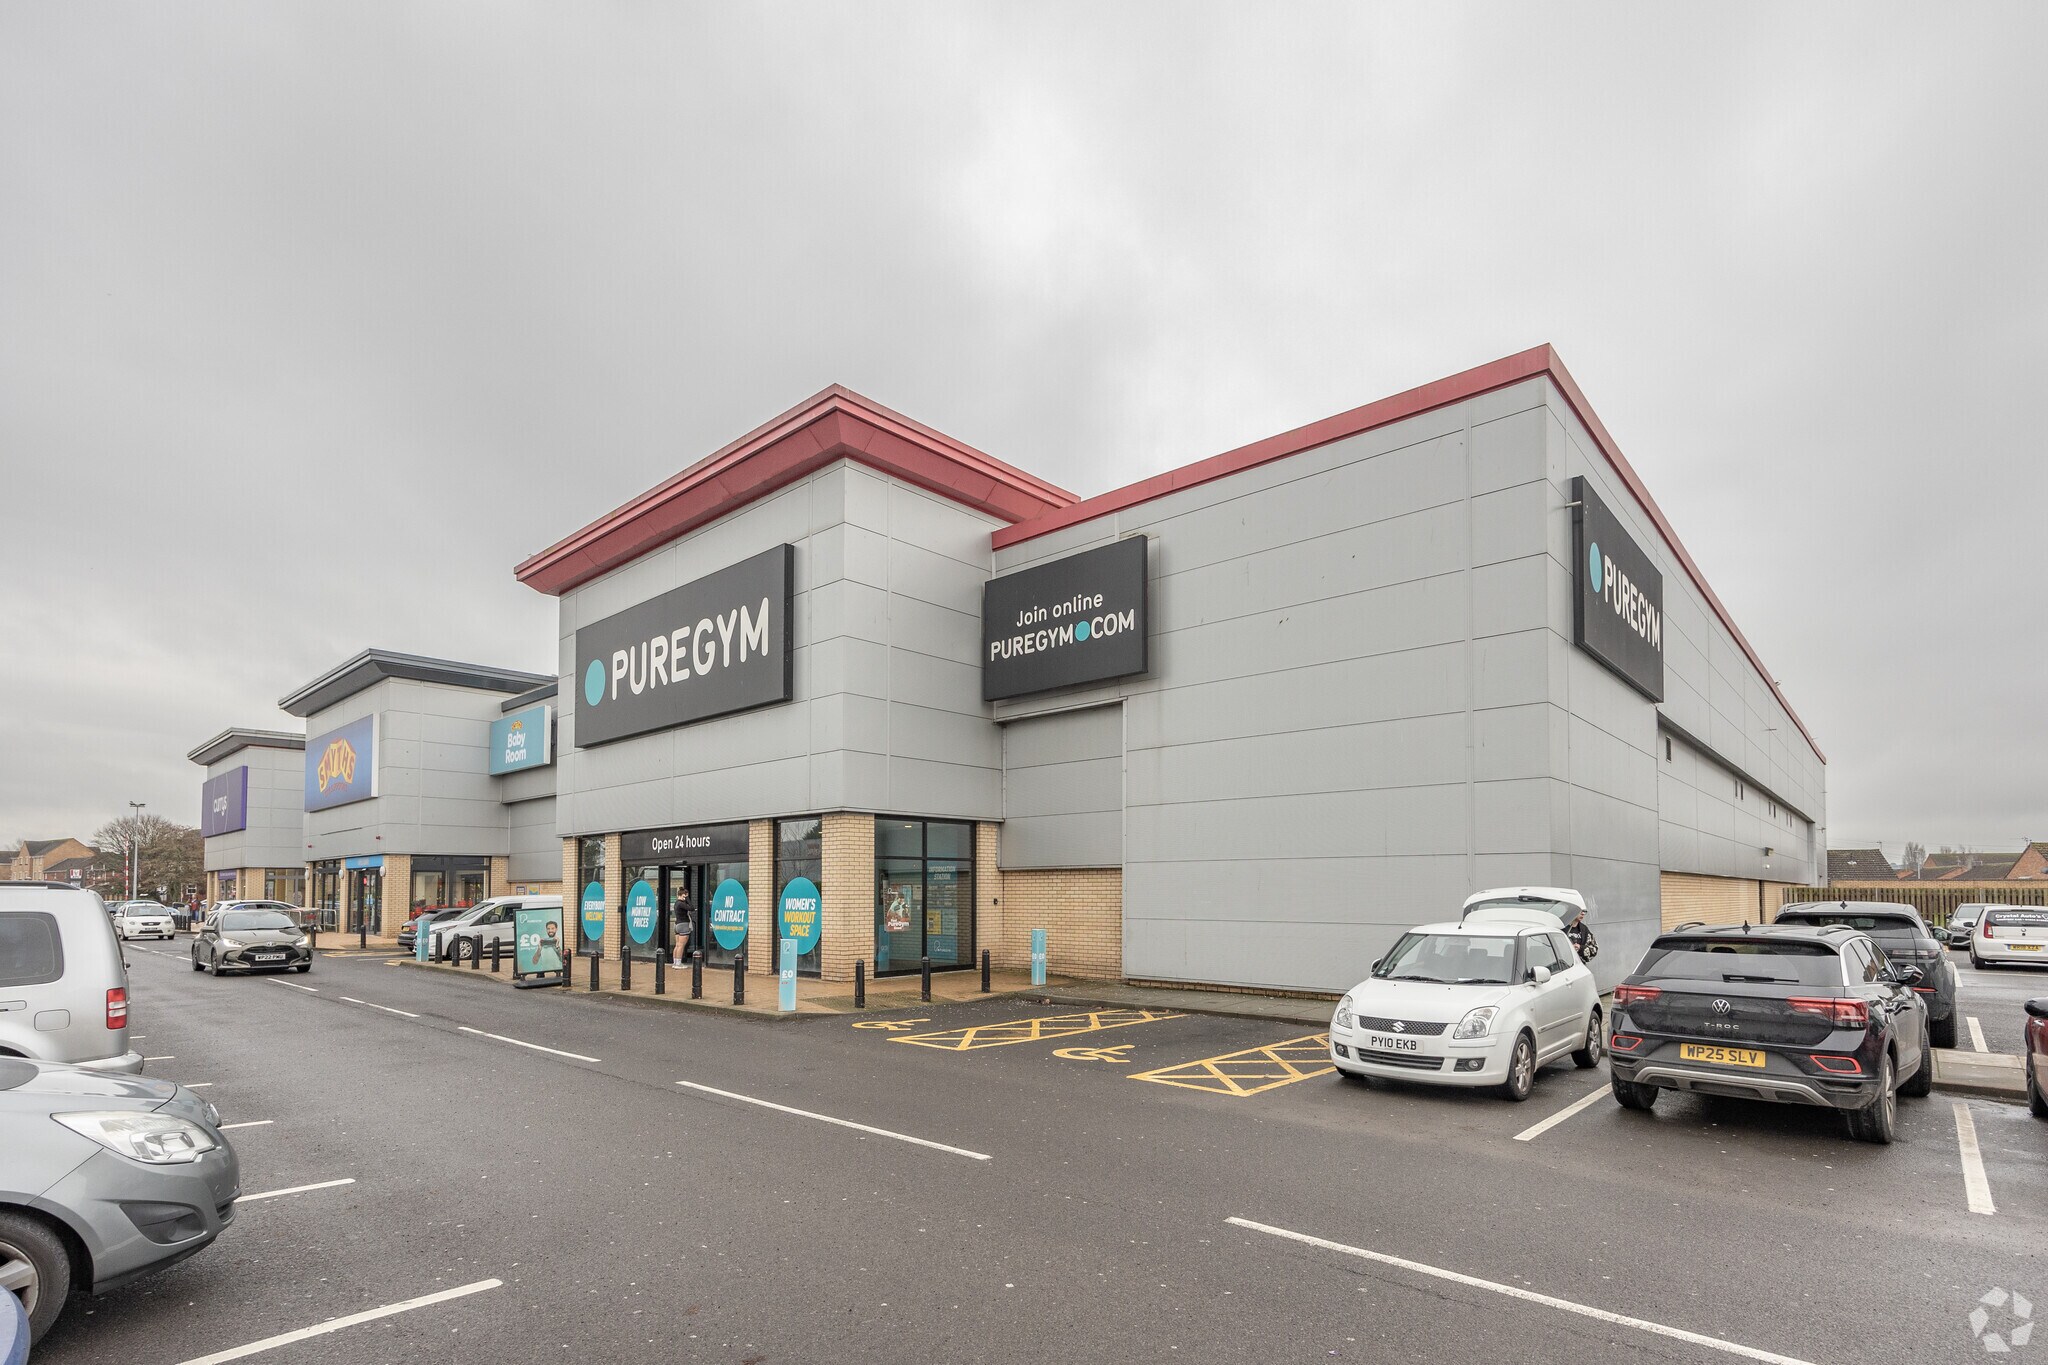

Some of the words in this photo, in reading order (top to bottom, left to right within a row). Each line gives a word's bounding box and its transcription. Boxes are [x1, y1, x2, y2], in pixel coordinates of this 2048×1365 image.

[1016, 605, 1047, 627] Join
[1052, 593, 1103, 617] online
[1604, 554, 1660, 652] PUREGYM
[611, 597, 769, 700] PUREGYM
[507, 731, 525, 748] Baby
[505, 748, 527, 764] Room
[318, 740, 356, 791] SMYTHS
[651, 837, 673, 853] Open
[675, 835, 685, 849] 24
[686, 835, 711, 848] hours
[636, 895, 648, 906] LOW
[724, 895, 734, 909] NO
[785, 898, 816, 911] WOMEN'S
[631, 906, 652, 917] MONTHLY
[714, 909, 746, 923] CONTRACT
[784, 911, 816, 924] WORKOUT
[633, 917, 650, 928] PRICES
[790, 925, 810, 937] SPACE
[519, 933, 540, 947] £0
[781, 969, 794, 979] £0
[1704, 1022, 1740, 1030] T-ROC
[1371, 1036, 1393, 1048] PY10
[1396, 1039, 1417, 1050] EKB
[1687, 1045, 1724, 1061] WP25
[1728, 1050, 1758, 1064] SLV
